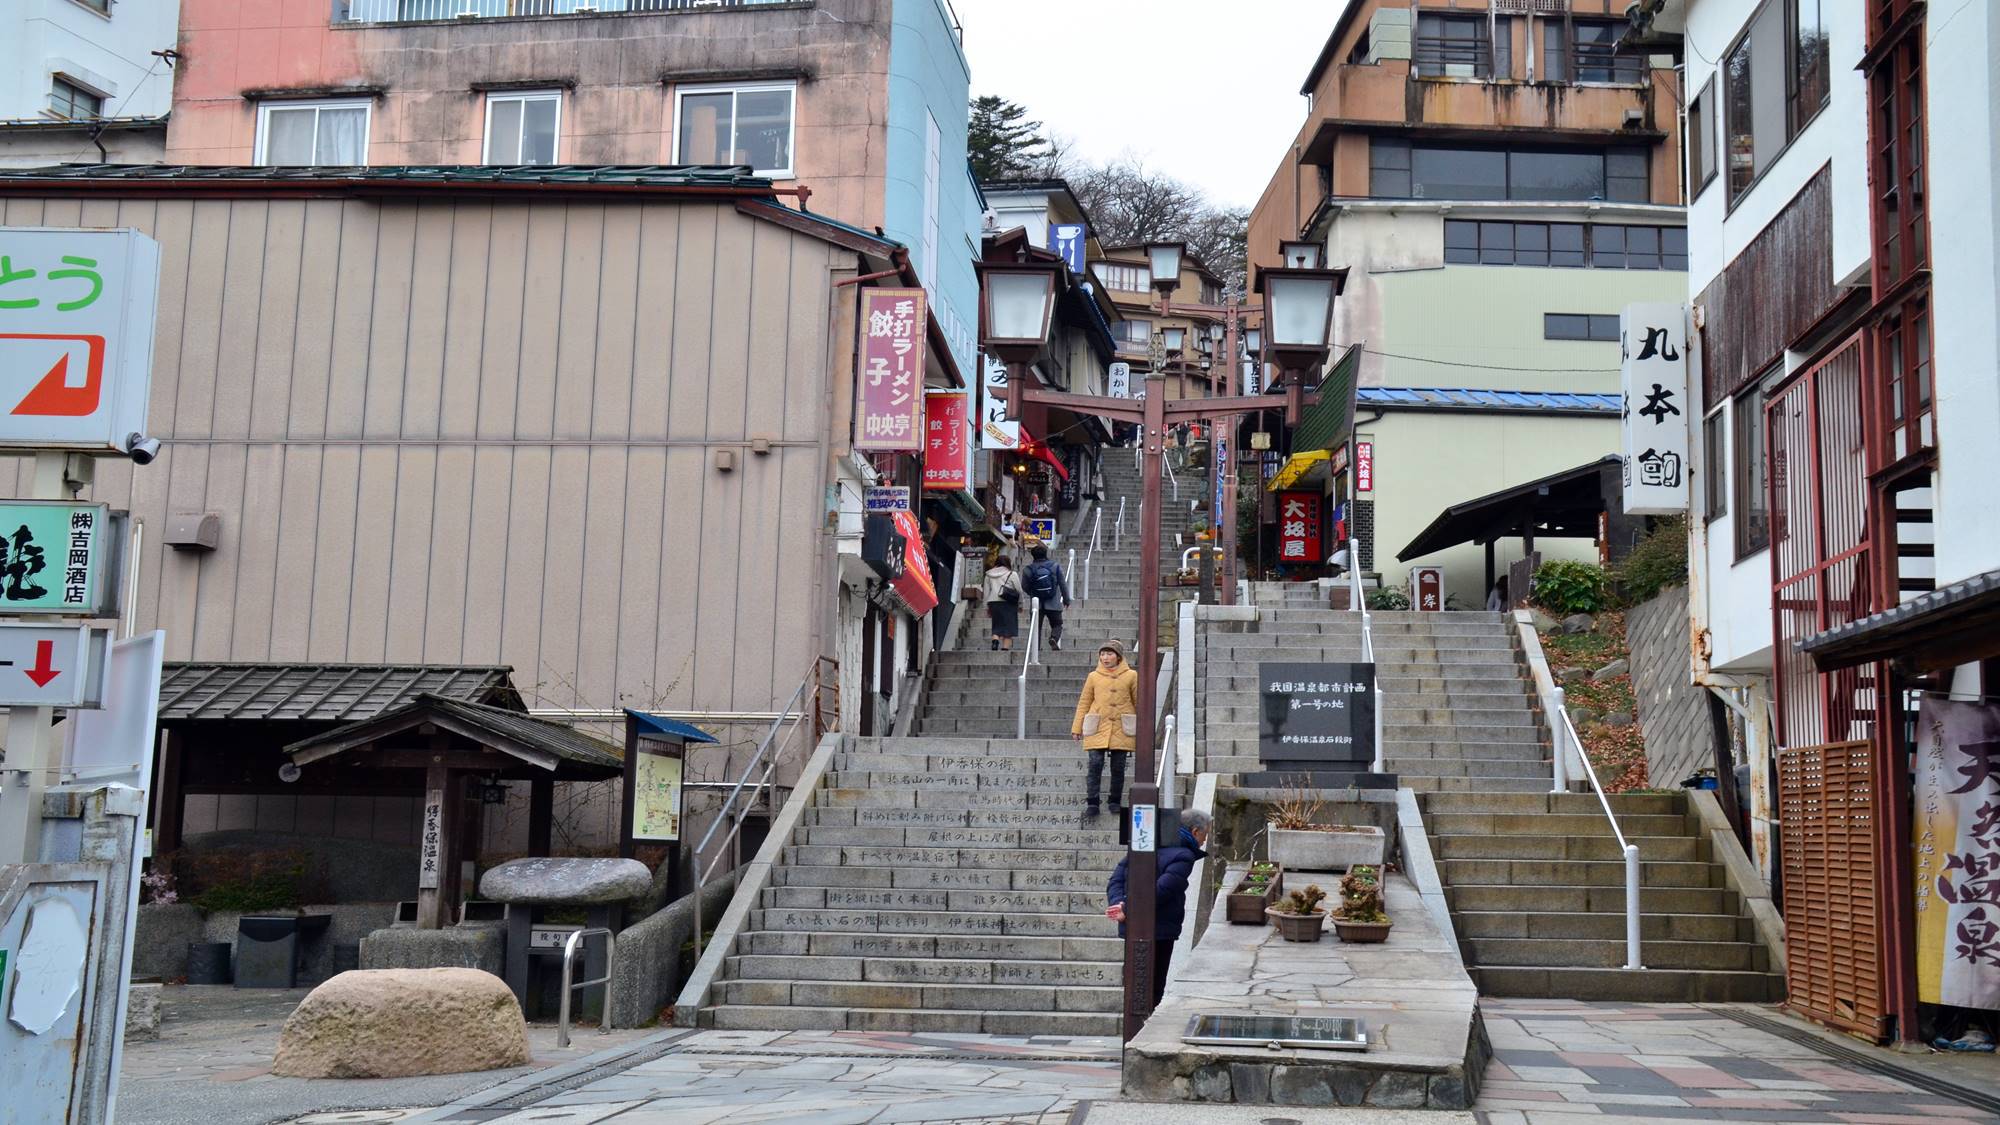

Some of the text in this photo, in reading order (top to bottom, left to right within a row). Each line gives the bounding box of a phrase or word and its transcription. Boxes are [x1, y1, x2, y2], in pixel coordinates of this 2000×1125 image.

[866, 310, 893, 386] 餃子
[891, 300, 914, 406] 手打ラーメン
[866, 413, 910, 437] 中央亭
[930, 420, 943, 448] 餃子
[926, 469, 963, 480] 中央亭
[1269, 682, 1366, 693] 我国温泉都市計画
[1290, 699, 1344, 710] 第一号の地
[424, 804, 439, 872] 伊香保温泉
